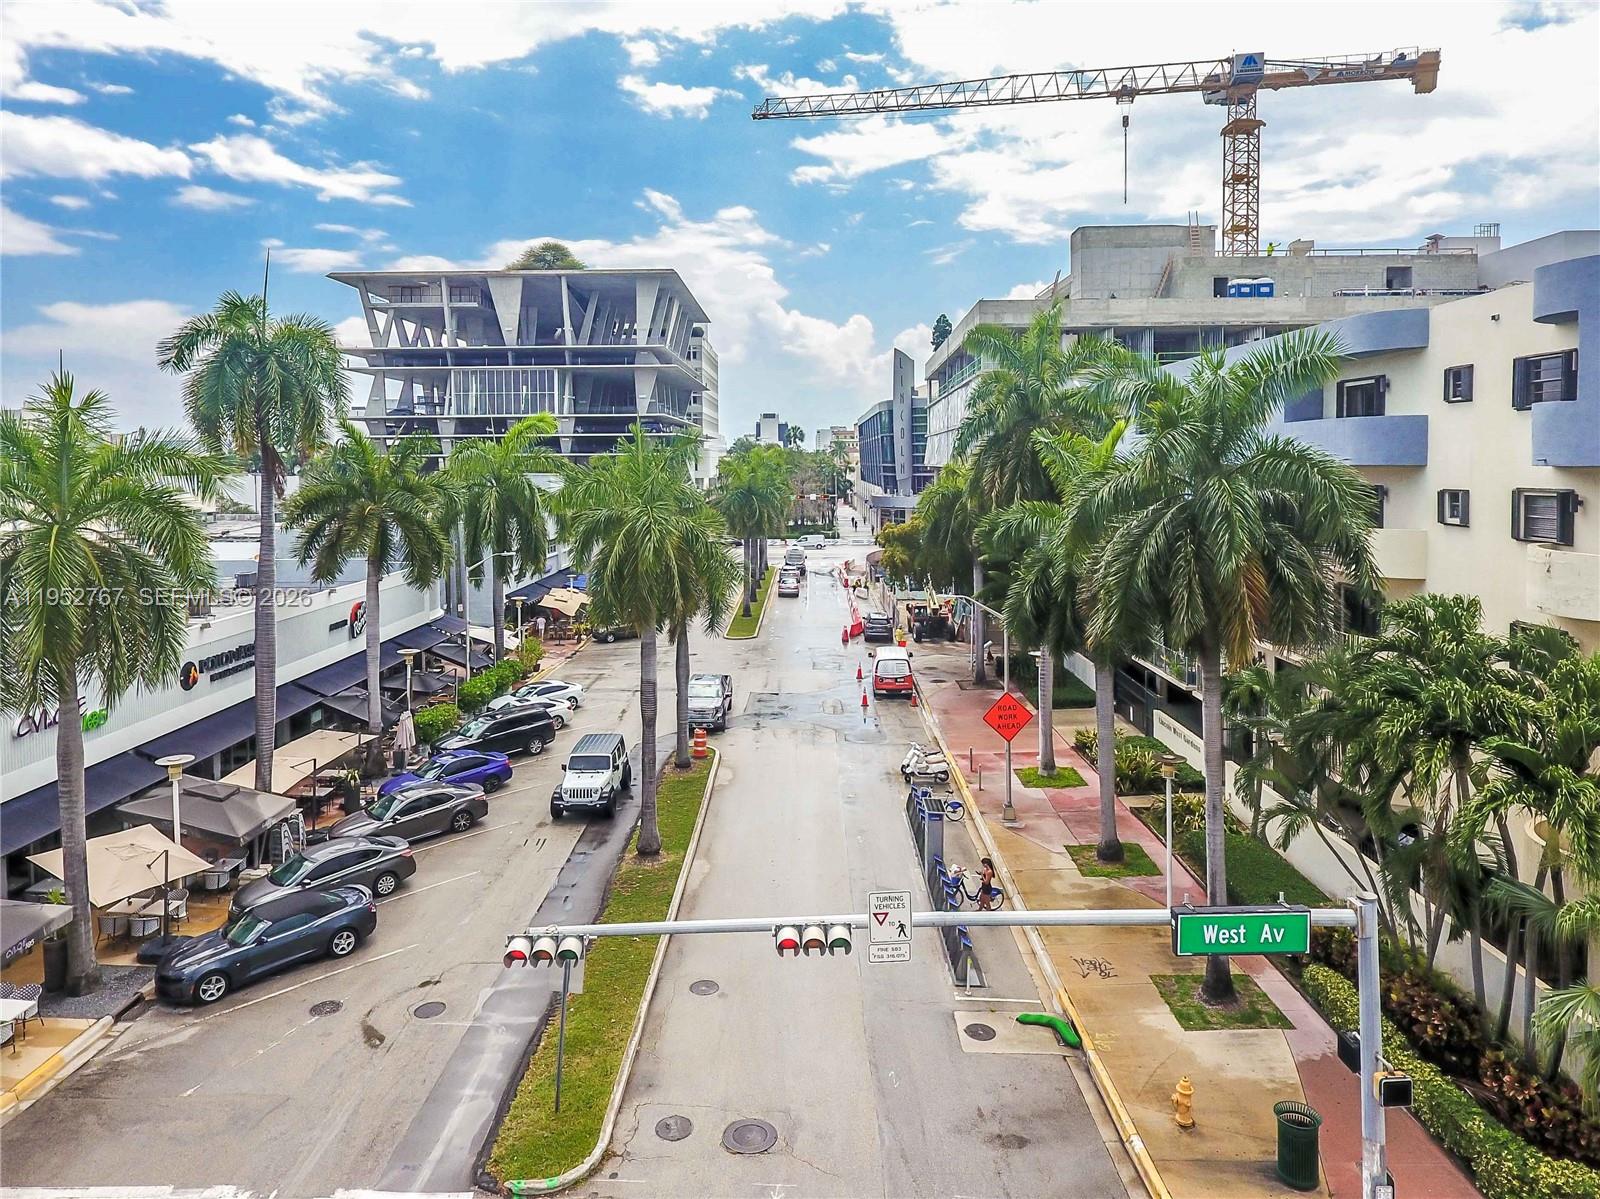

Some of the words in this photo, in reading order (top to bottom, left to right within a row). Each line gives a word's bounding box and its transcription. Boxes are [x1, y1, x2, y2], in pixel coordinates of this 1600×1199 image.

[997, 704, 1017, 712] ROAD
[998, 713, 1018, 721] WORK
[996, 722, 1021, 730] AHEAD
[876, 895, 904, 903] TURNING
[874, 902, 906, 910] VEHICLES
[1203, 924, 1247, 944] West
[1260, 923, 1285, 943] Av
